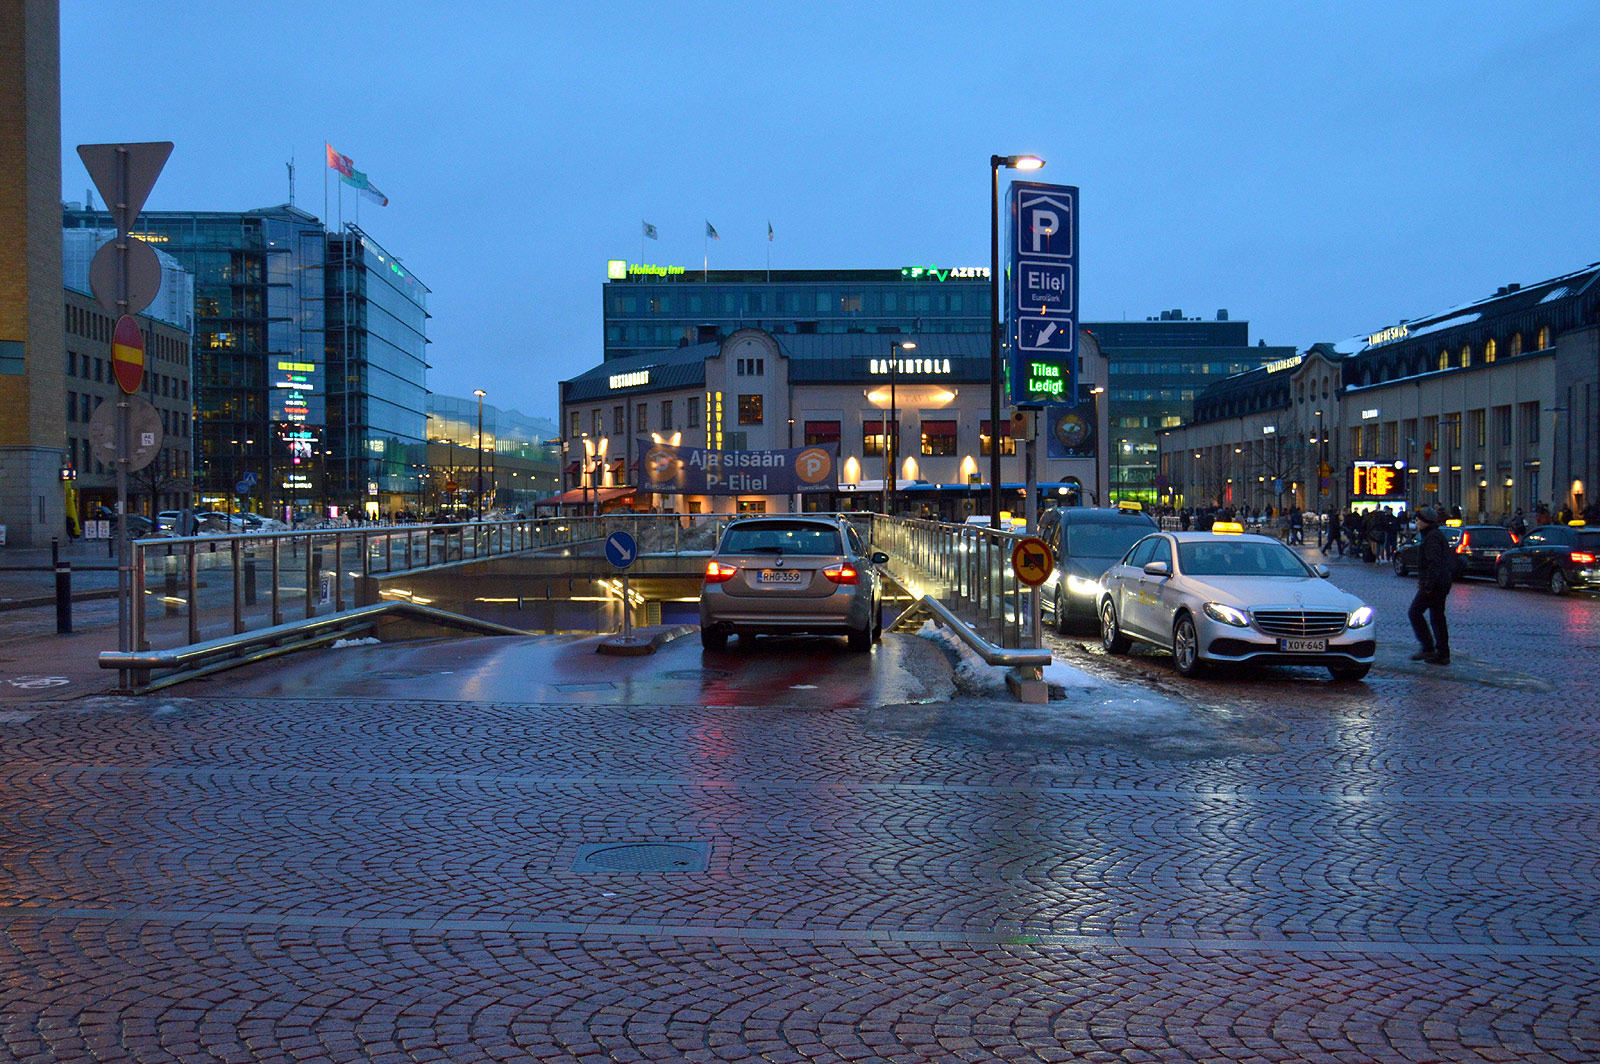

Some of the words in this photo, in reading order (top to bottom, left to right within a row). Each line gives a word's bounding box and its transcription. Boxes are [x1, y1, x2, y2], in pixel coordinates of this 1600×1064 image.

[1032, 209, 1060, 252] P
[629, 263, 668, 277] Holiday
[668, 265, 685, 275] Inn
[950, 267, 991, 278] AZETS
[1028, 271, 1065, 291] Eliel
[1031, 362, 1059, 377] Tilaa
[1029, 378, 1064, 395] Ledigt
[689, 449, 719, 471] Aja
[723, 449, 785, 468] sisään
[706, 474, 768, 491] P-Eliel
[763, 572, 800, 582] RHG-359
